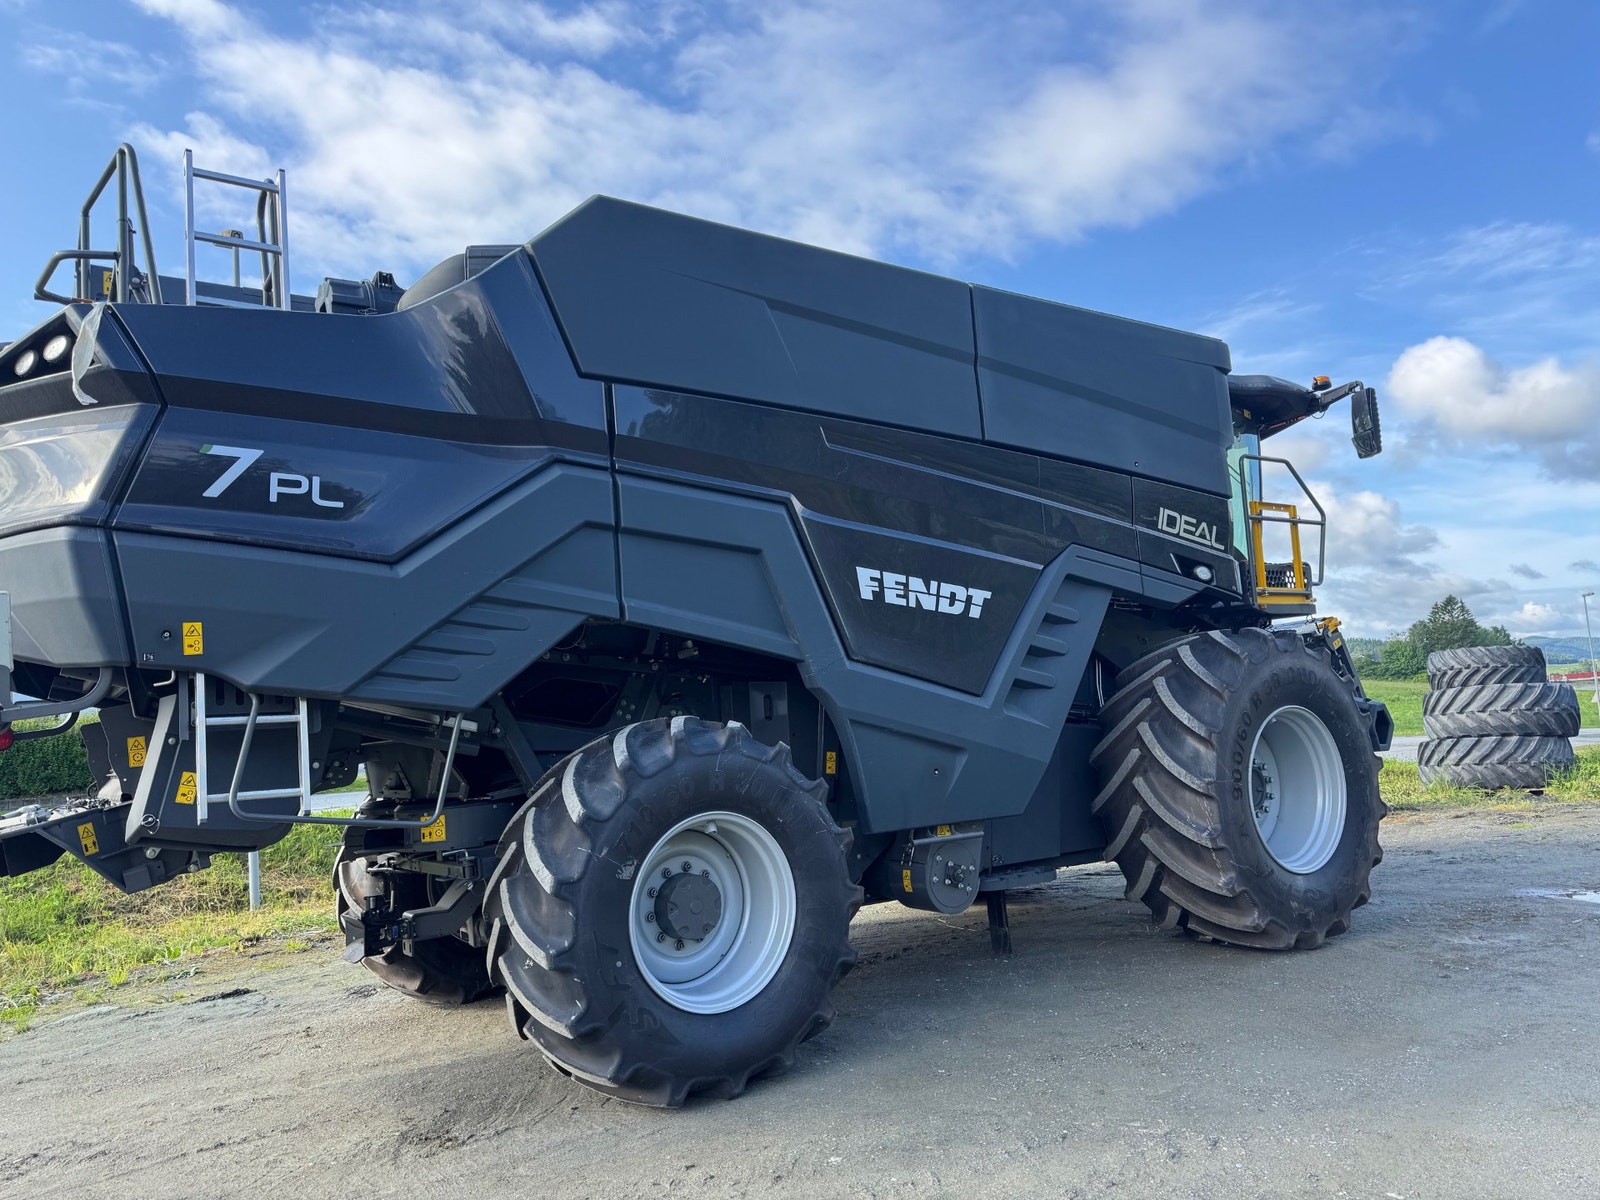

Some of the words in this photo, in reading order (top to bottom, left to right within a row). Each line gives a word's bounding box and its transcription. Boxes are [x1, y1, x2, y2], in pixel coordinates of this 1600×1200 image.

[199, 444, 264, 498] 7
[269, 472, 344, 508] PL
[1157, 507, 1225, 550] IDEAL
[855, 566, 992, 619] FENDT
[1231, 711, 1252, 800] 900/60
